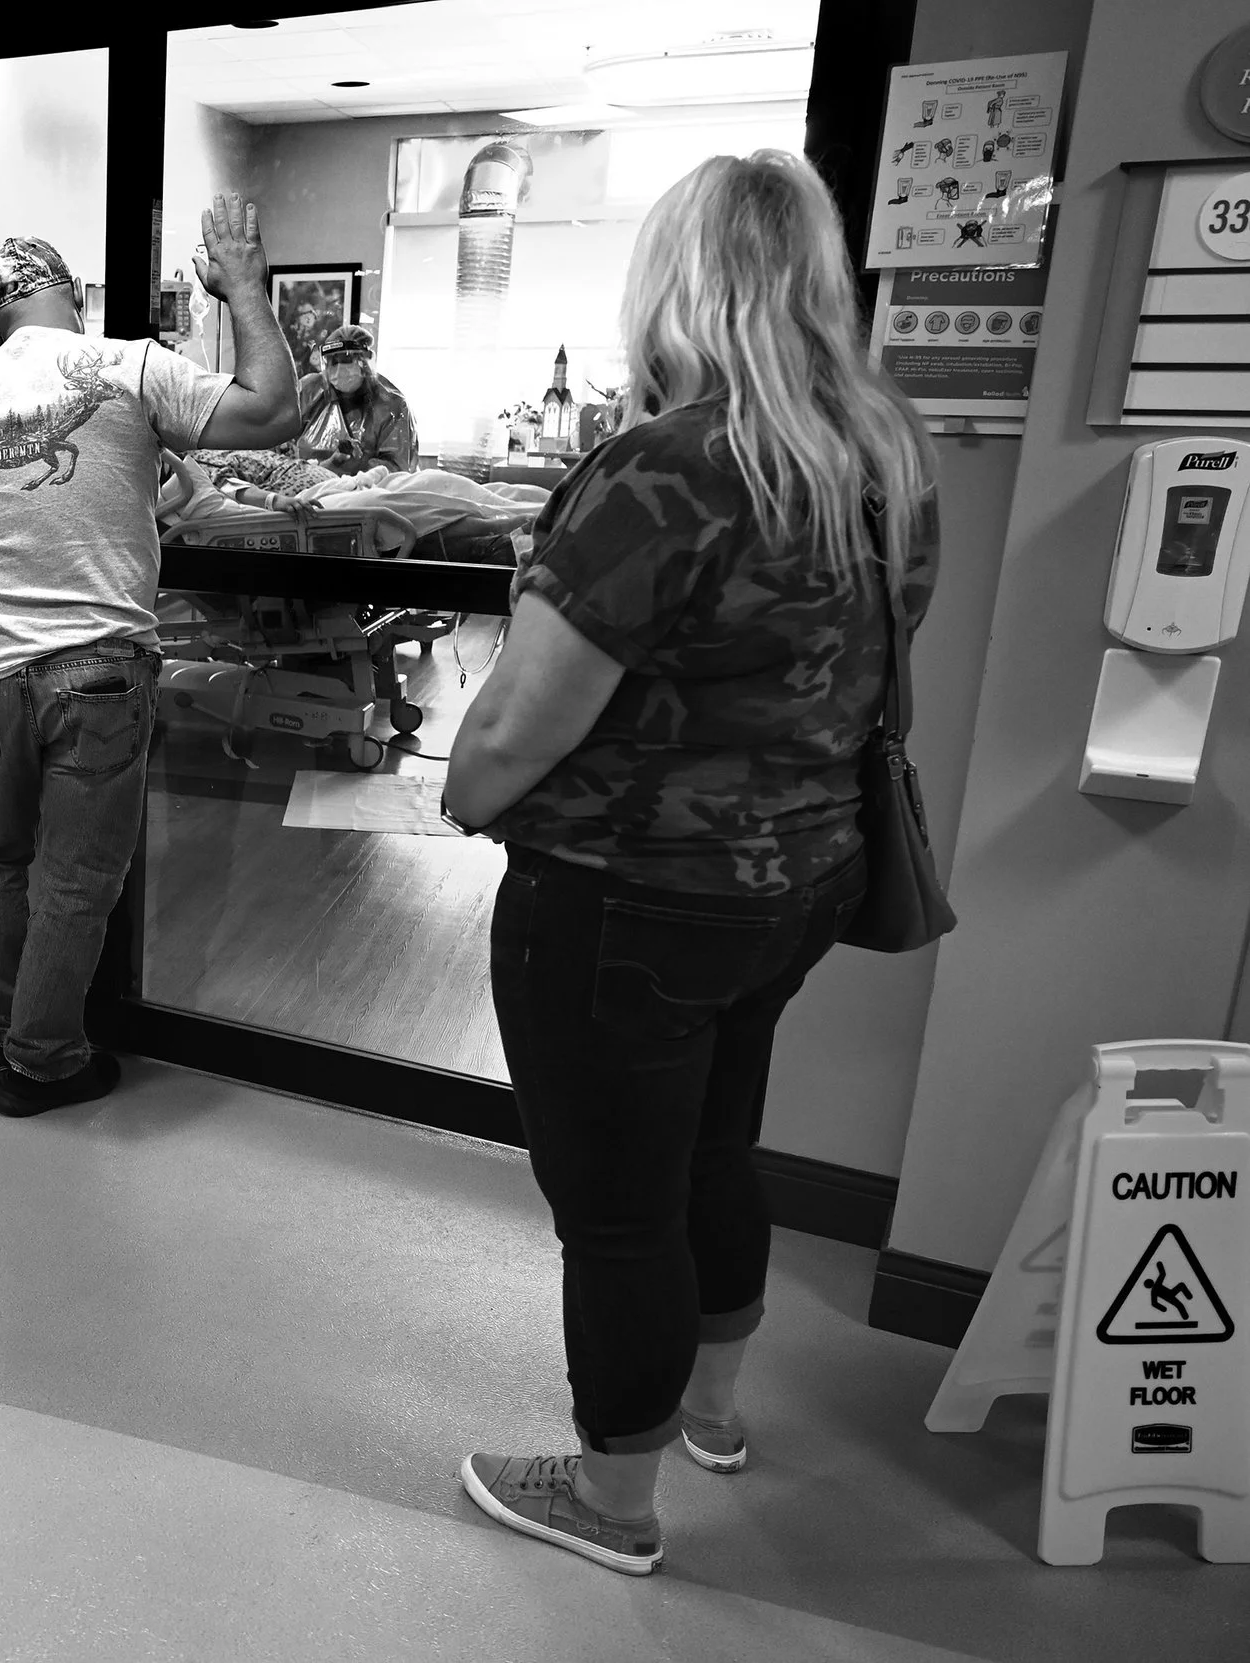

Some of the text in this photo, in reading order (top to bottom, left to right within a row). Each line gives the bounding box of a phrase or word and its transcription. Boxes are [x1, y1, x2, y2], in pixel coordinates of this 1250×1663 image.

[948, 76, 974, 84] COVID-19
[1209, 199, 1250, 233] 33
[910, 269, 1016, 283] Precautions
[1185, 455, 1230, 468] Purell
[1112, 1171, 1238, 1201] CAUTION
[1142, 1360, 1187, 1380] WET
[1130, 1386, 1197, 1406] FLOOR
